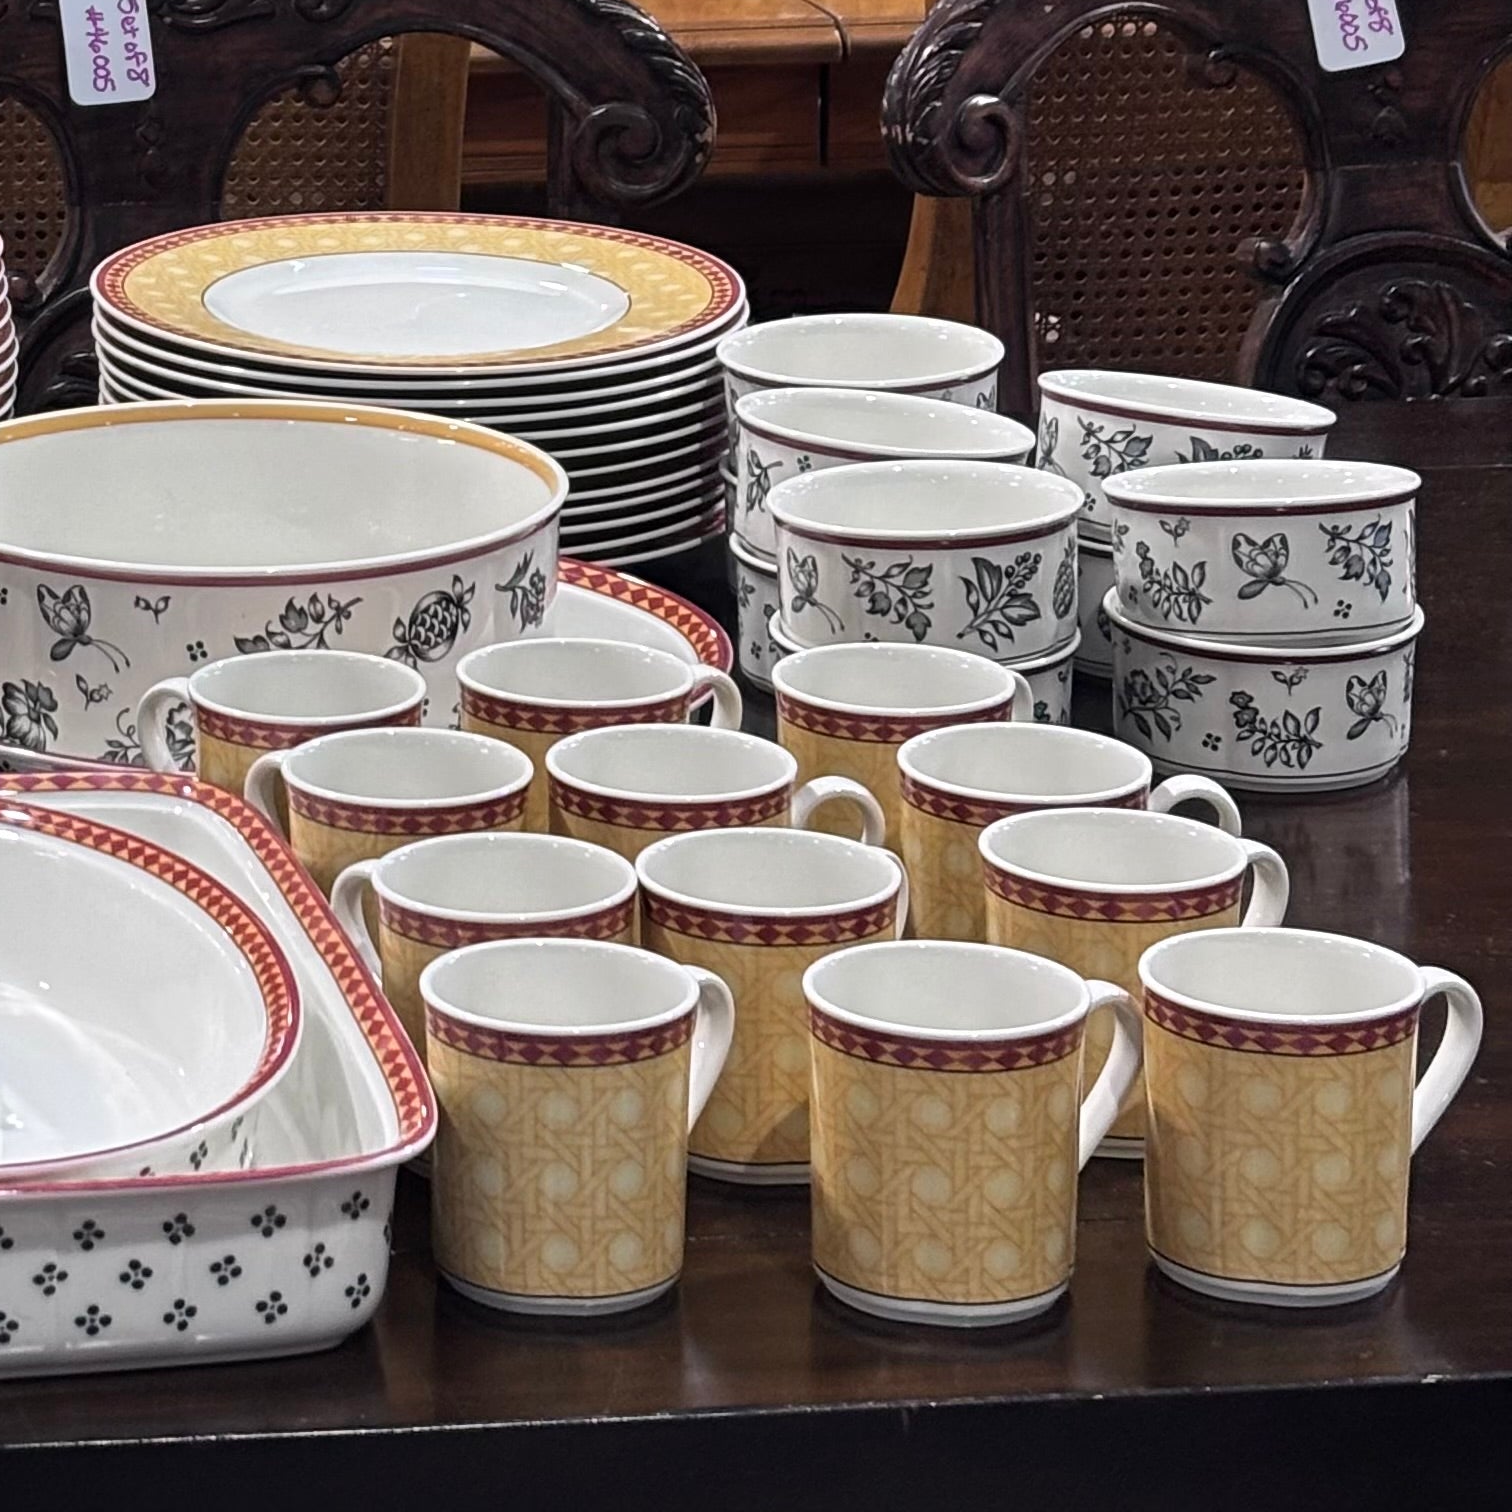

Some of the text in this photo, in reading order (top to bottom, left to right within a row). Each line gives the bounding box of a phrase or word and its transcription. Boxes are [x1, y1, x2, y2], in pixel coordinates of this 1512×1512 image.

[85, 5, 116, 92] #46005
[124, 43, 148, 67] of
[126, 68, 150, 87] 8
